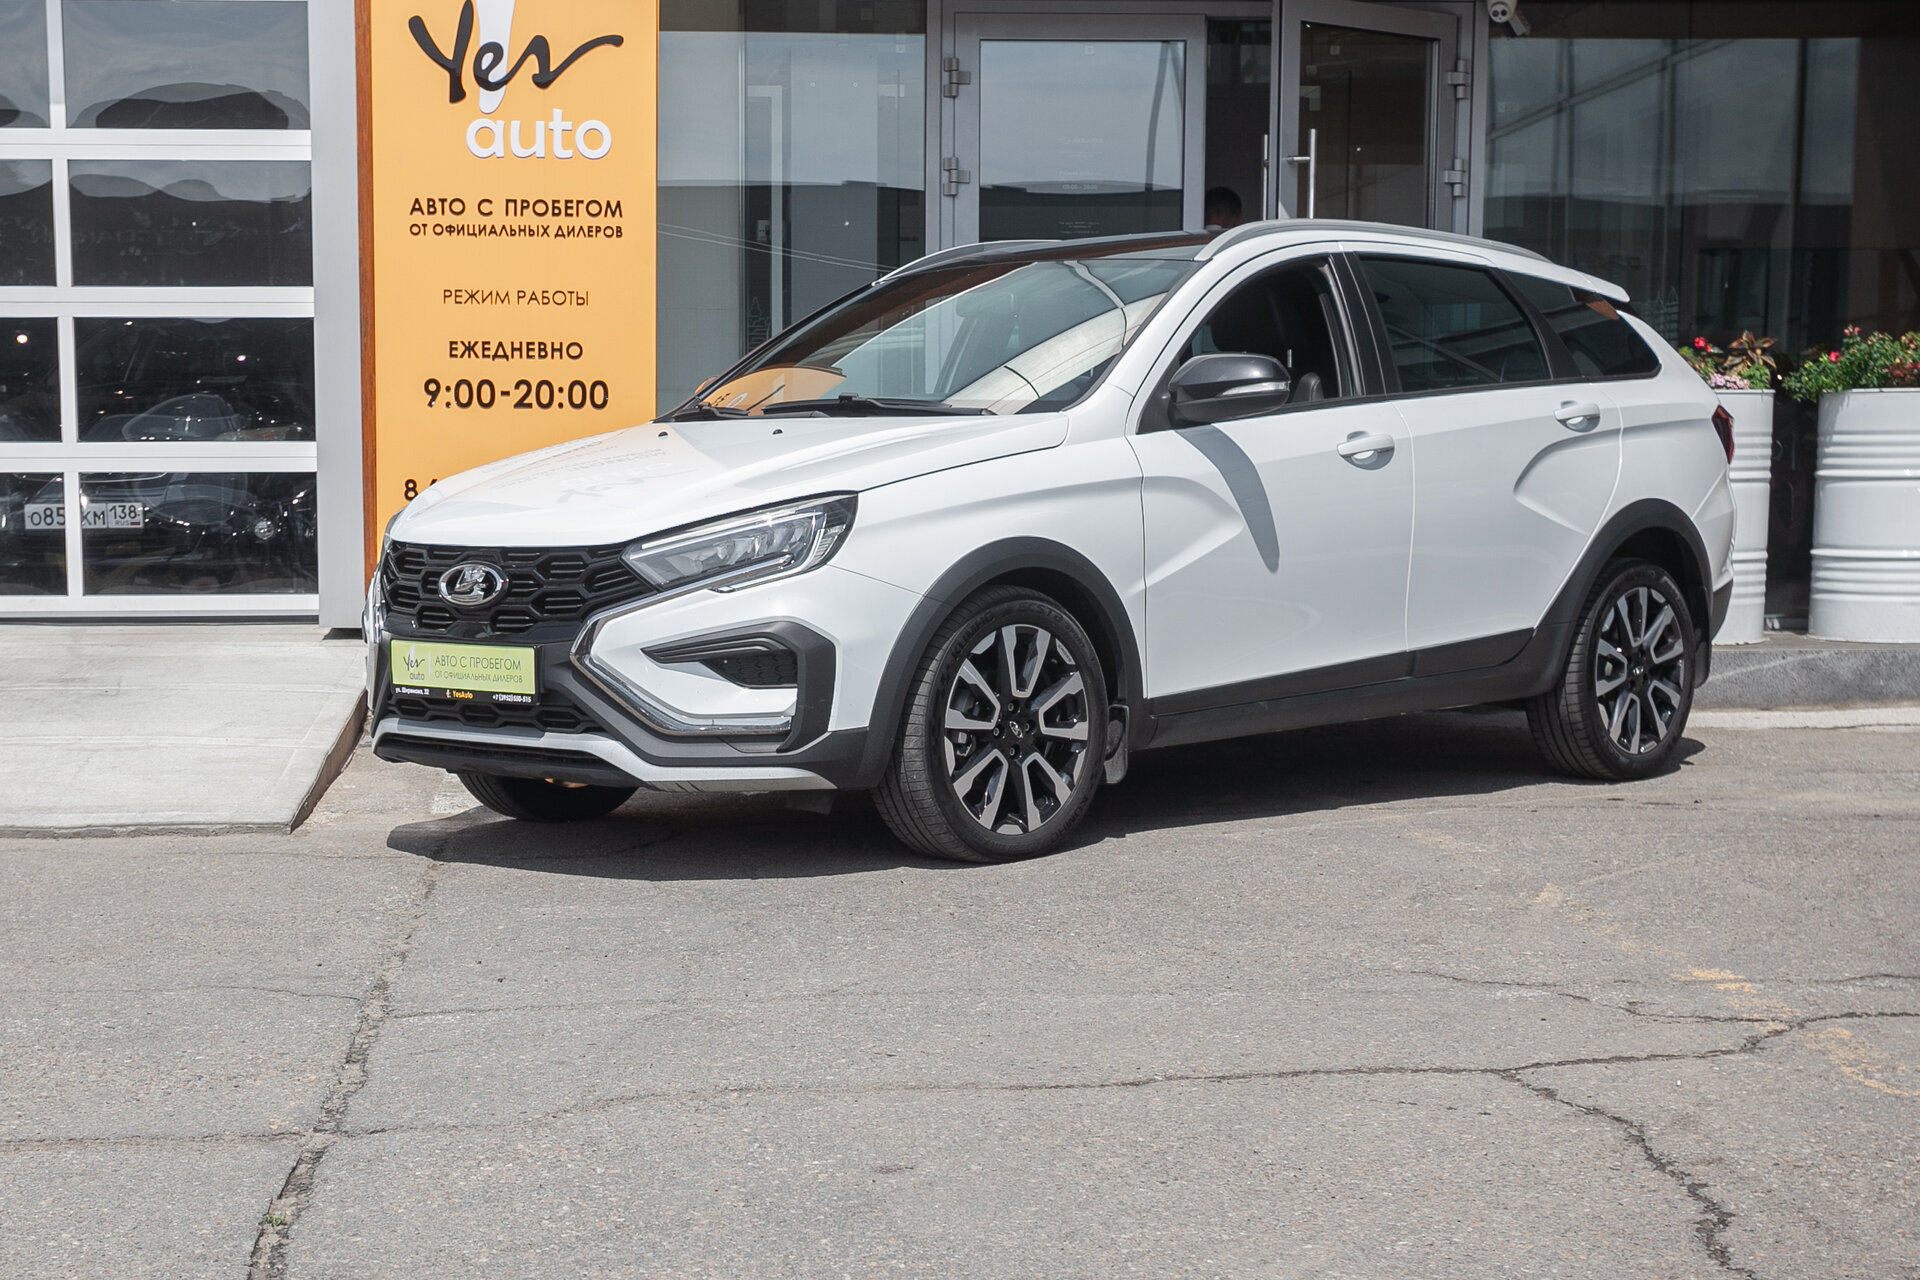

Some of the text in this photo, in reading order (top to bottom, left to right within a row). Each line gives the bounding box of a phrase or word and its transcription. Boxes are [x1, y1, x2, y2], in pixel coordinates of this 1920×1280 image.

[408, 0, 625, 104] Yes
[466, 109, 612, 159] auto
[409, 197, 623, 218] АВТО С ПРОБЕГОМ
[409, 223, 623, 240] ОТ ОФИЦИАЛЬНЫХ ДИЛЕРОВ
[443, 289, 589, 306] РЕЖИМ РАБОТЫ
[449, 340, 584, 362] ЕЖЕДНЕВНО
[423, 377, 609, 411] 9:00-20:00
[109, 505, 137, 520] 138
[403, 653, 426, 671] Yes
[435, 655, 522, 671] АВТО С ПРОБЕГОМ
[409, 673, 426, 681] auto
[435, 671, 523, 684] ОТ ОФИЦИАЛЬНЫХ ДИЛЕРОВ
